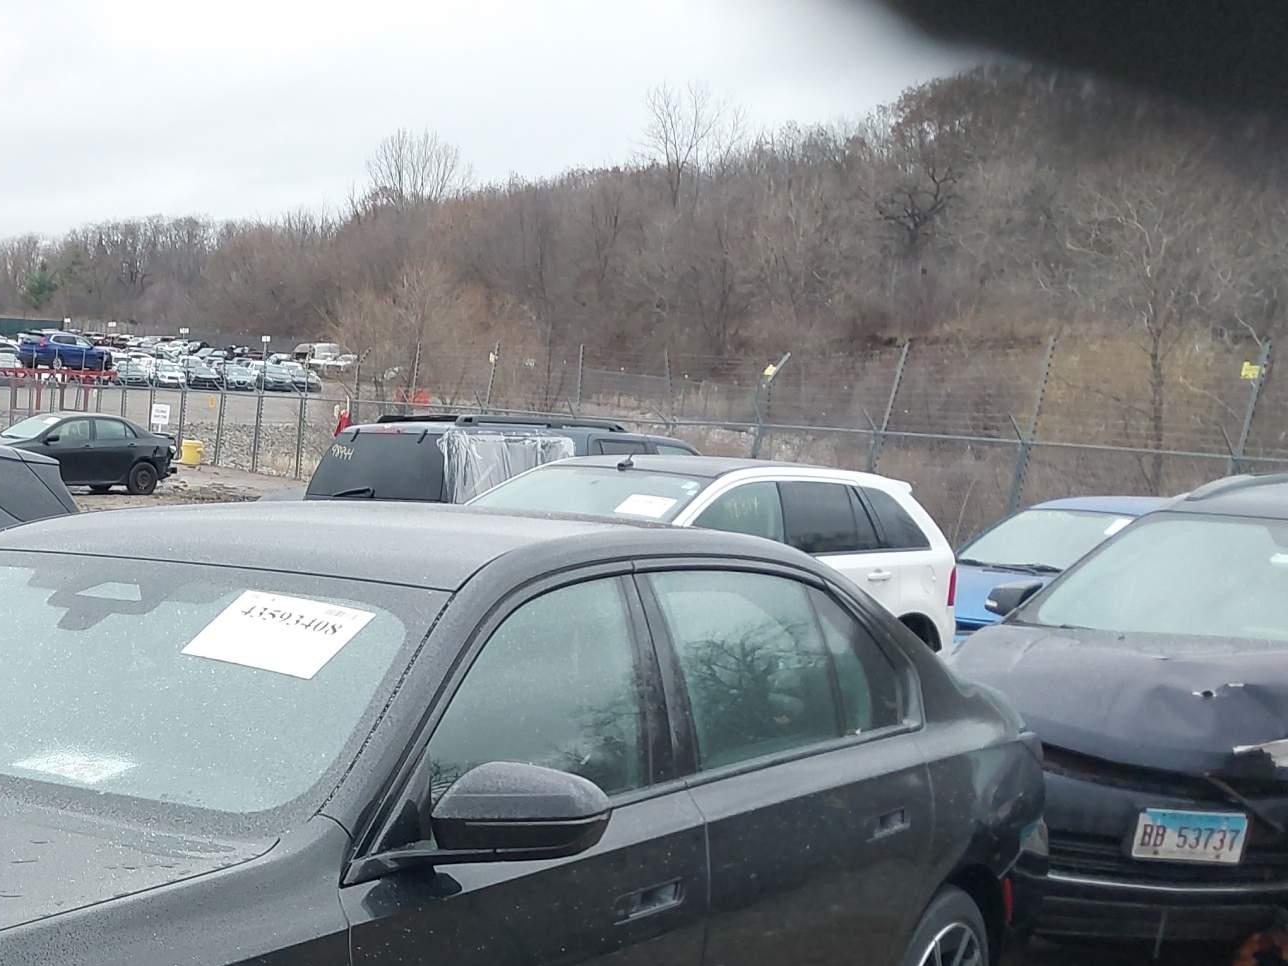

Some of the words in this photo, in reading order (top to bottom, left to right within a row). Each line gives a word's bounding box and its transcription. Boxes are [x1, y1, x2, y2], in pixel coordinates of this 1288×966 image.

[241, 605, 343, 635] 43593408
[1140, 823, 1167, 847] BB
[1176, 826, 1241, 852] 53737
